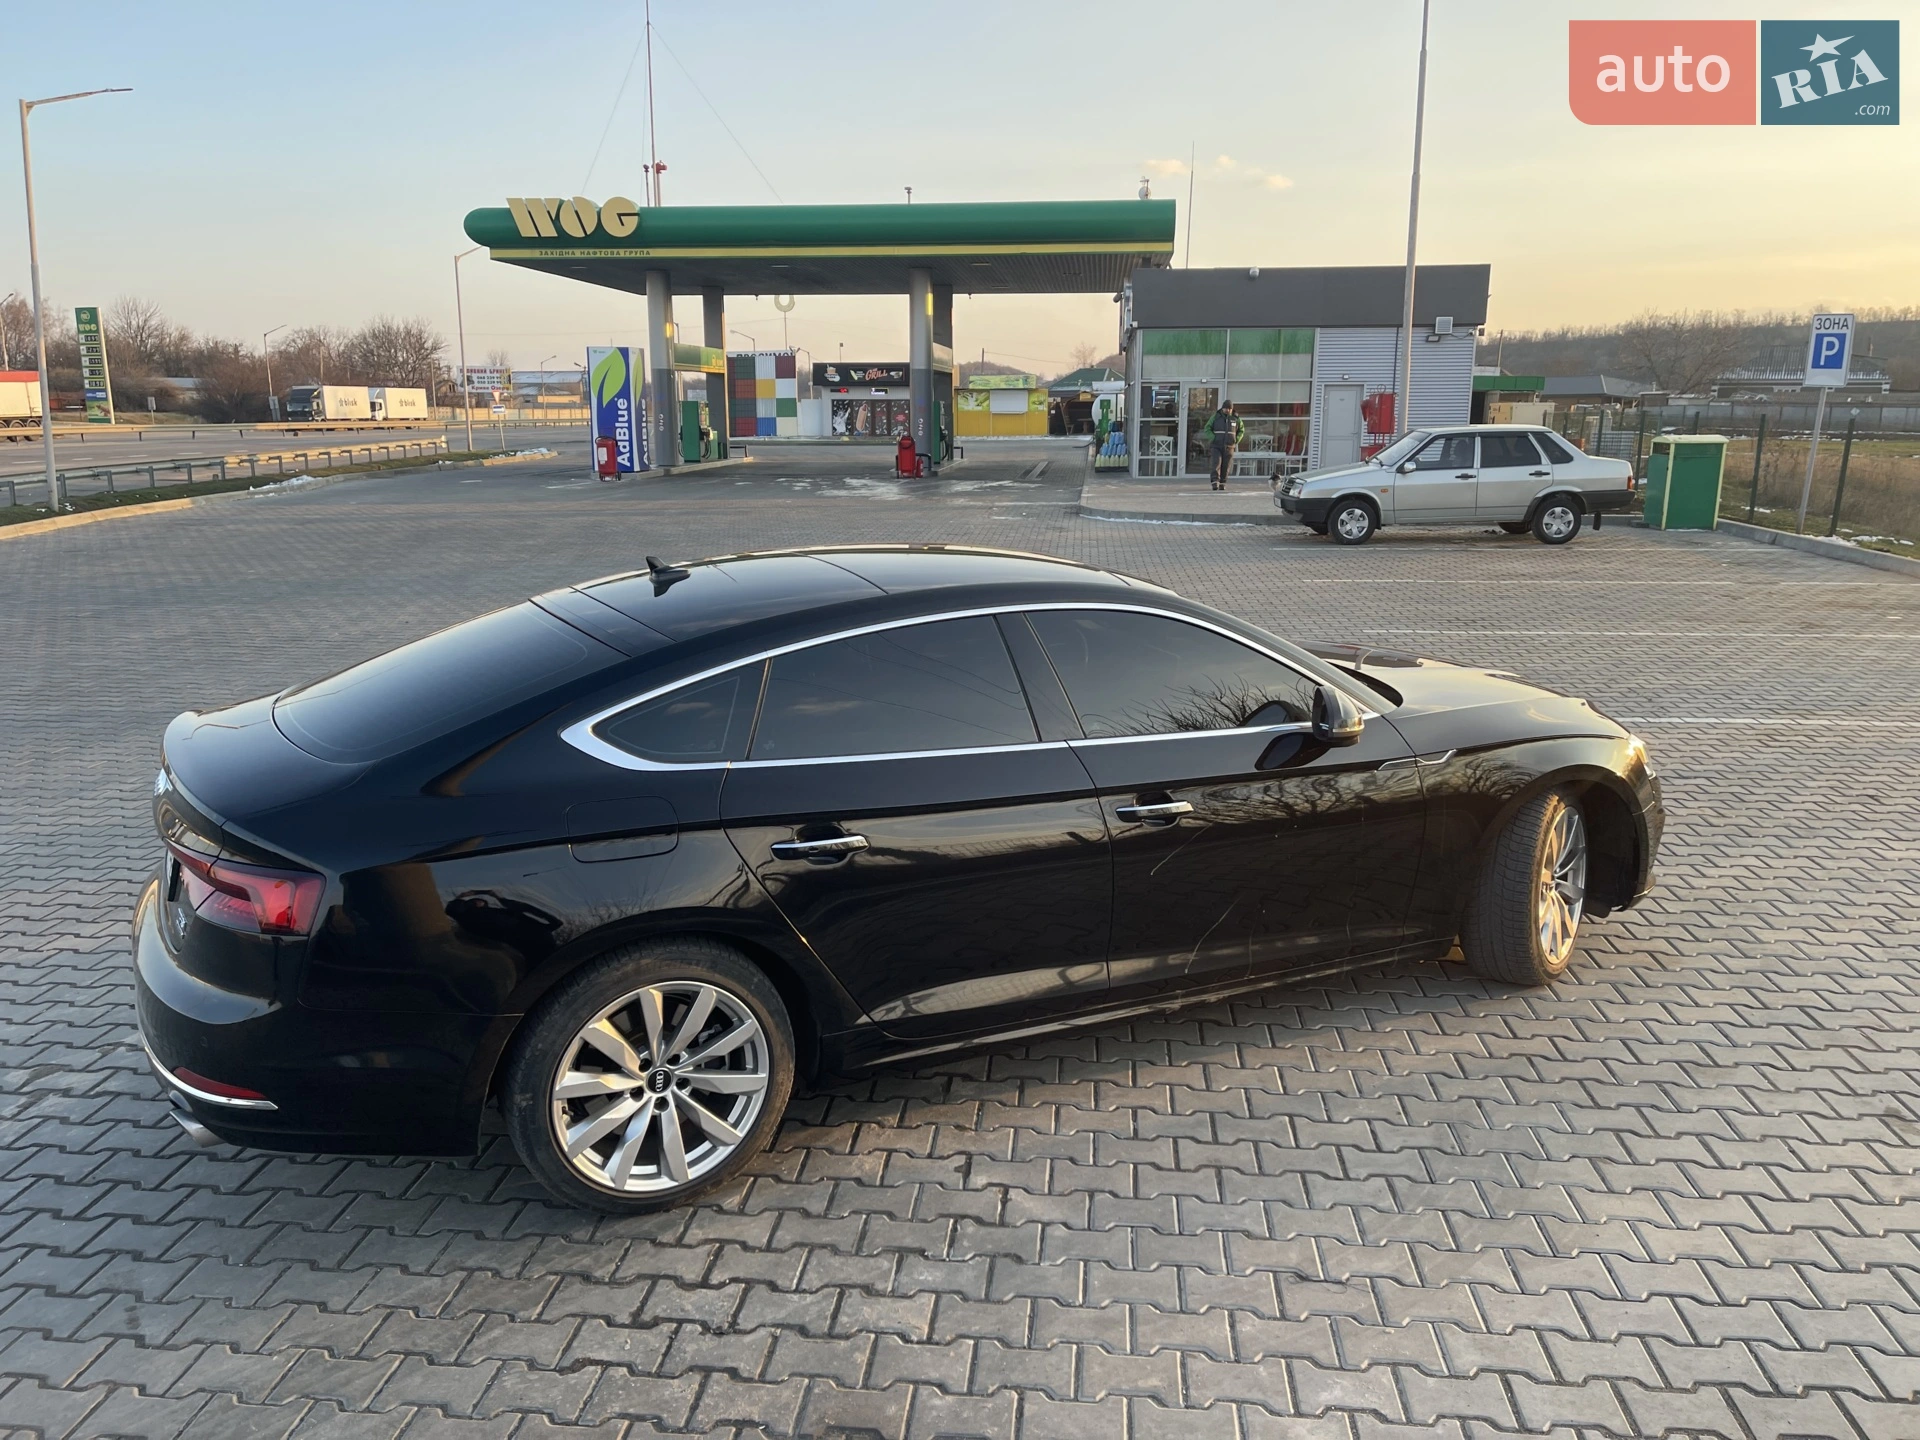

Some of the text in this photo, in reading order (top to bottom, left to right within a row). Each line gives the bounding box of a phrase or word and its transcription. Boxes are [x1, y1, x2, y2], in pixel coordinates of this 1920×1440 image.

[506, 196, 639, 238] WOG
[1815, 318, 1849, 330] ЗОНА
[1820, 336, 1840, 366] P
[615, 398, 631, 467] AdBlue
[641, 399, 649, 465] AdBlue
